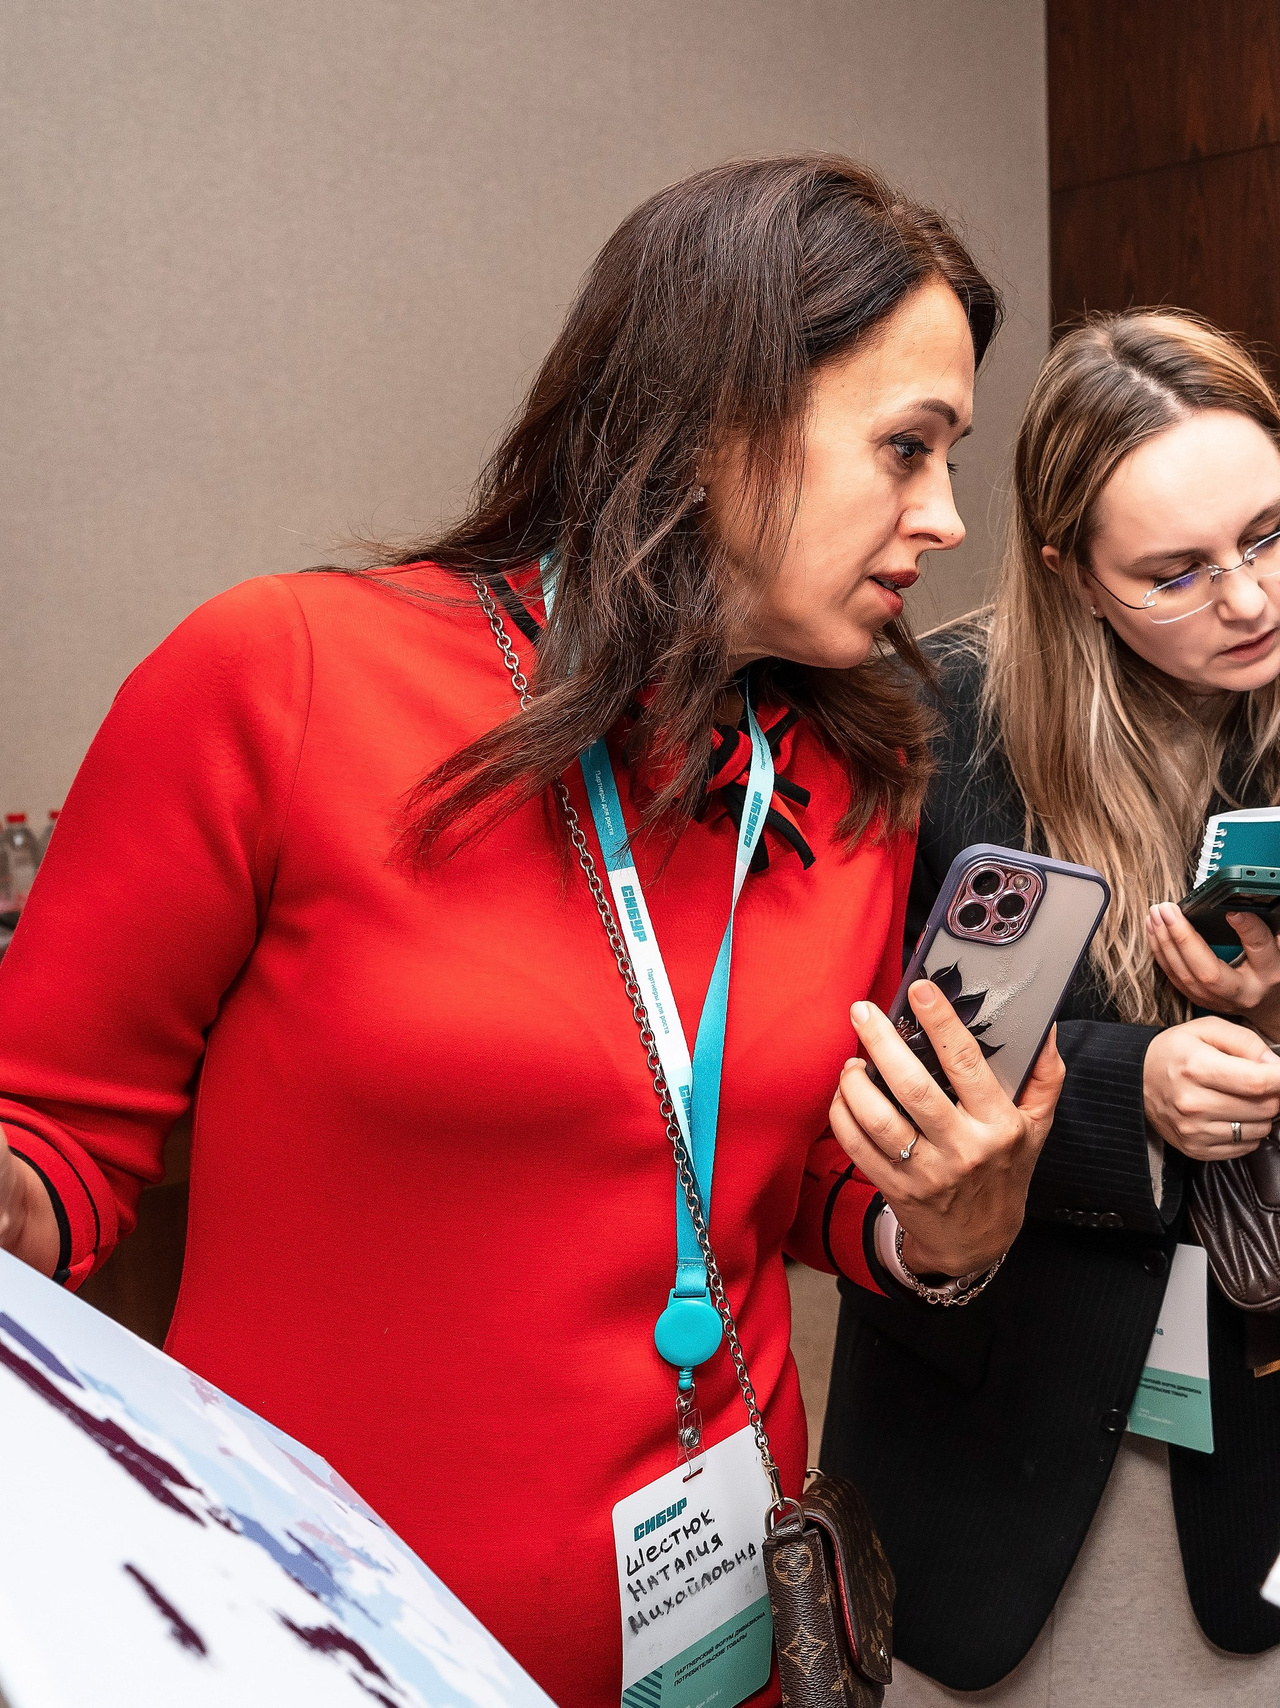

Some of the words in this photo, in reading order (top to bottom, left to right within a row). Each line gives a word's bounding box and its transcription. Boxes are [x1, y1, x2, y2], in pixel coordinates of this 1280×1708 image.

[604, 816, 614, 835] роста
[743, 791, 763, 848] СИБУР
[621, 885, 647, 942] СИБУР
[646, 967, 660, 1001] Партнеры
[655, 1001, 664, 1014] для
[659, 1015, 670, 1034] роста
[634, 1496, 688, 1542] СИБУР
[673, 1647, 726, 1686] ПОТРЕБИТЕЛЬСКИЕ
[726, 1632, 747, 1650] ТОВАРЫ
[674, 1646, 713, 1677] ПАРТНЕРСКИЙ
[715, 1633, 733, 1649] ФОРУМ
